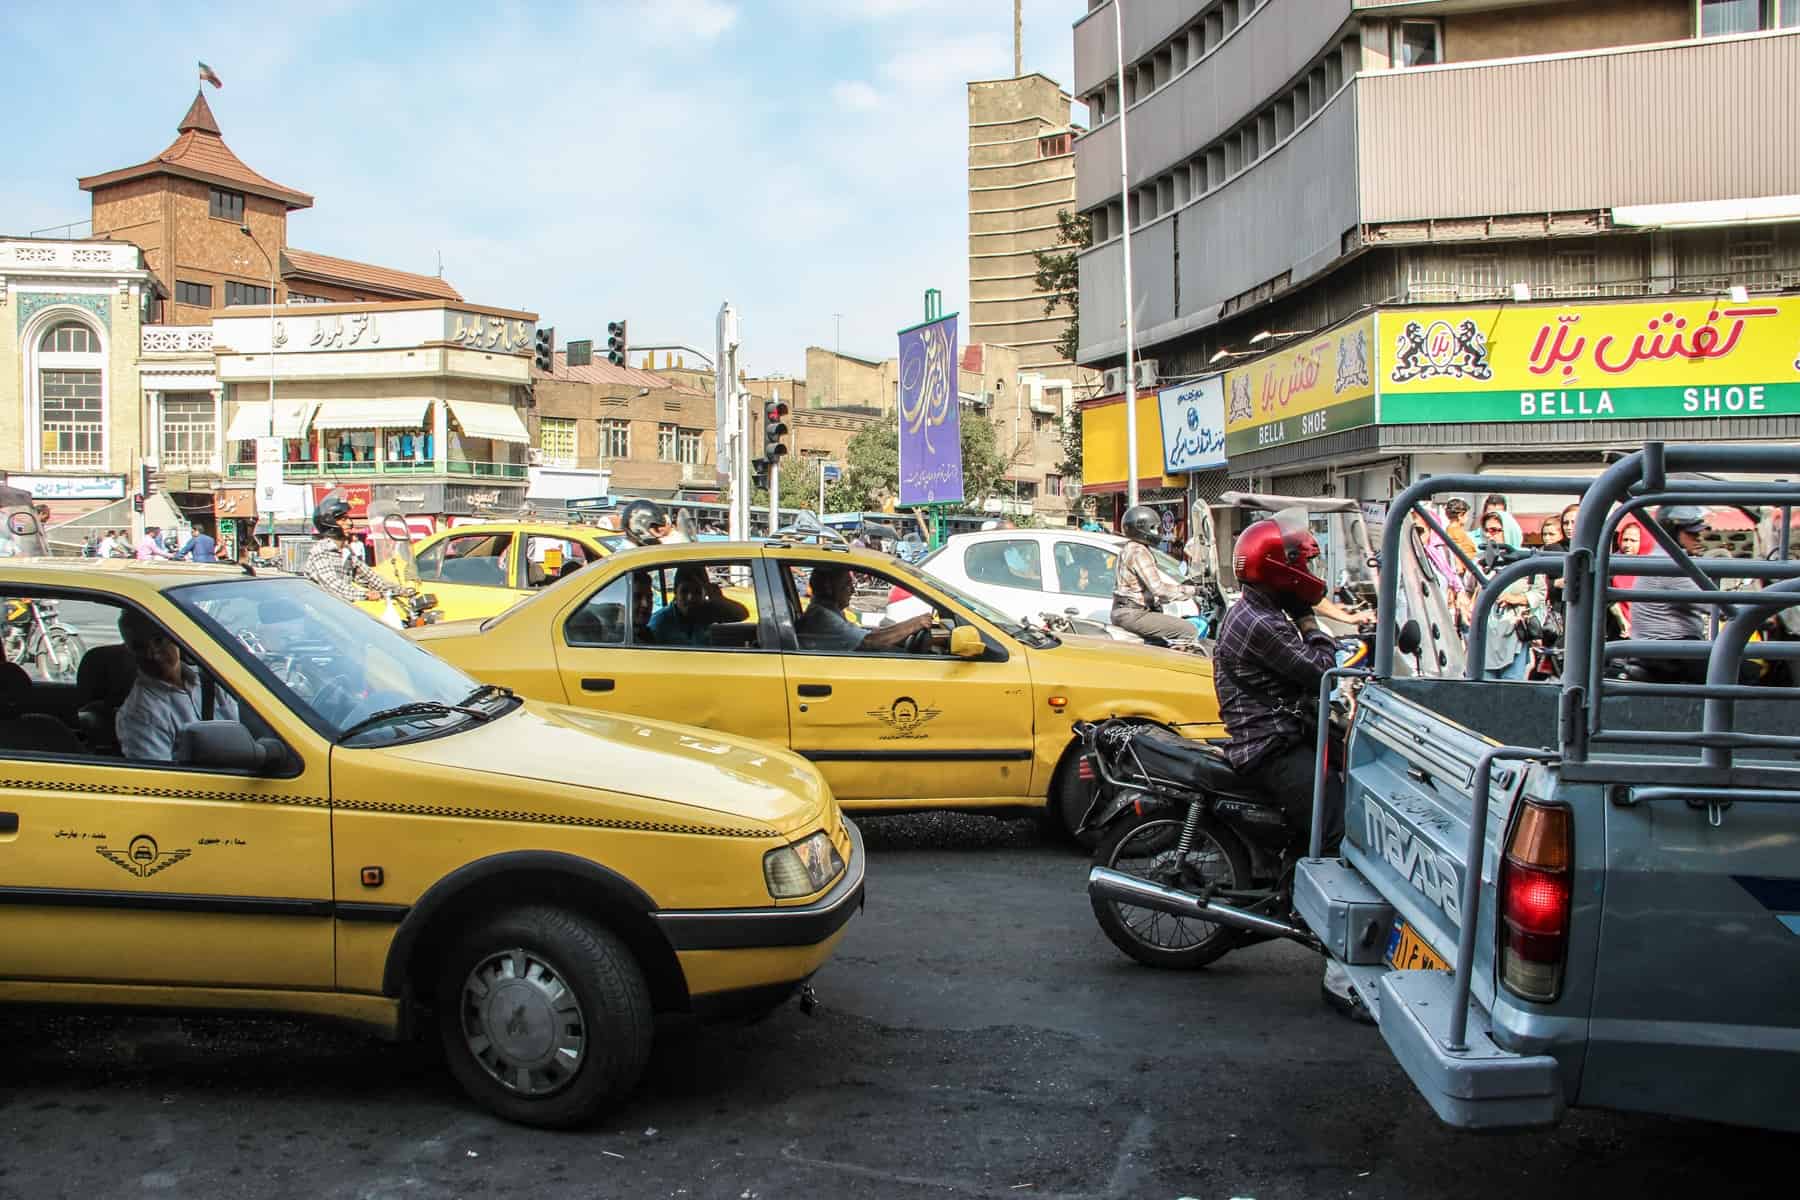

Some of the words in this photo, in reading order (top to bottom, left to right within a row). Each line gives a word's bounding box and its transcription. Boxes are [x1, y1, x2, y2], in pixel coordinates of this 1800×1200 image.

[1594, 308, 1778, 373] کفش
[1278, 342, 1330, 406] کفش
[1520, 391, 1614, 415] BELLA
[1683, 386, 1765, 411] SHOE
[1259, 422, 1285, 444] BELLA
[1302, 410, 1327, 435] SHOE
